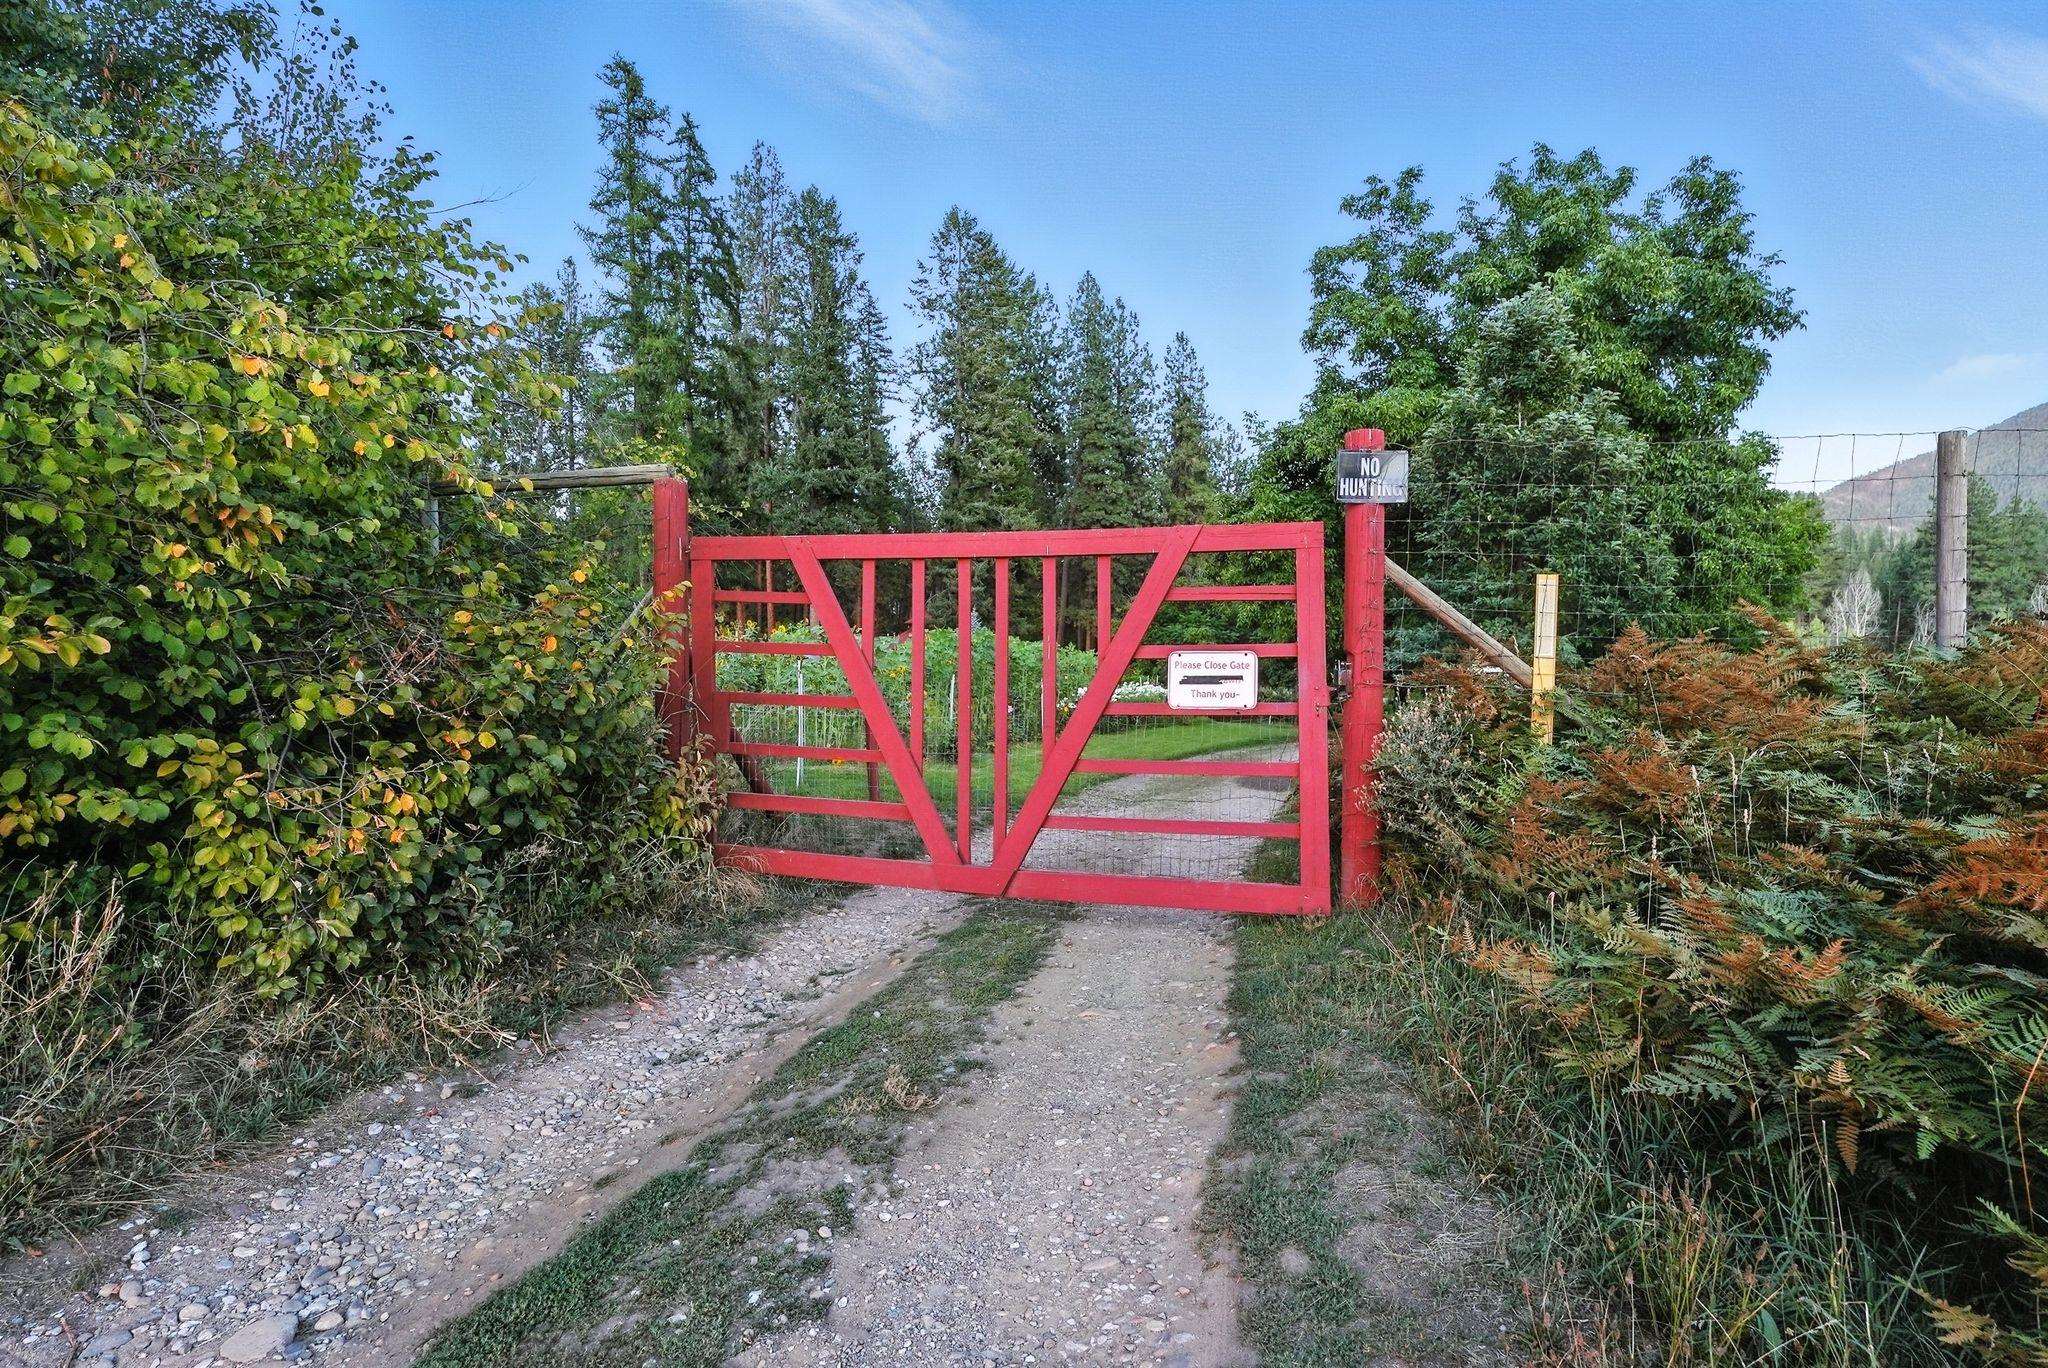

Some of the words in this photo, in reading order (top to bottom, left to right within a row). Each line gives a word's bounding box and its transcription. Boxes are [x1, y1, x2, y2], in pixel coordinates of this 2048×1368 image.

[1361, 457, 1381, 476] NO
[1174, 660, 1201, 670] Please
[1204, 660, 1227, 670] Close
[1229, 660, 1250, 670] Gate
[1191, 689, 1217, 698] Thank
